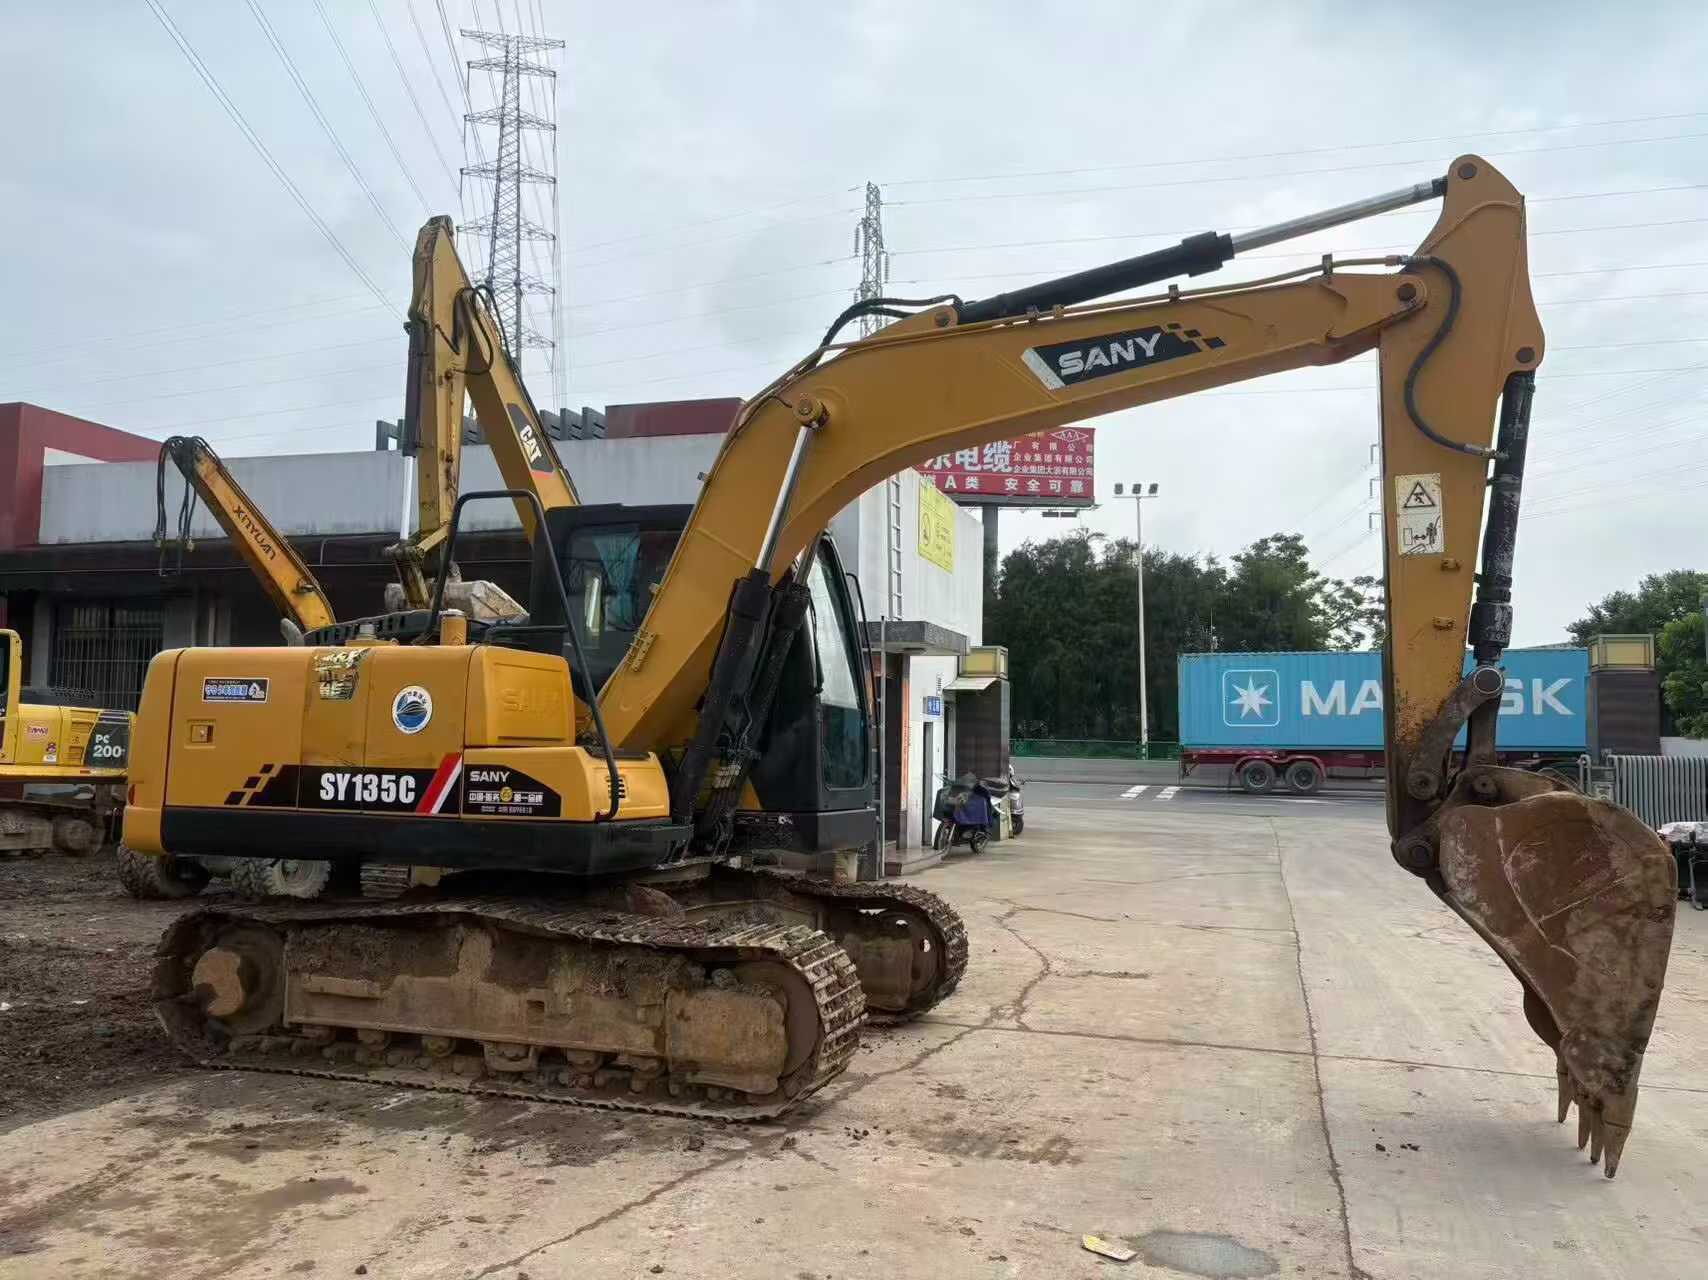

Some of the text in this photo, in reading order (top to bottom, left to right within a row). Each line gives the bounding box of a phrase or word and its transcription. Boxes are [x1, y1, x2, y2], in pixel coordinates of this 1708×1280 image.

[1059, 333, 1161, 376] SANY
[519, 424, 542, 463] CAT
[1004, 477, 1085, 494] 安全可靠
[1301, 678, 1575, 716] MASK
[95, 733, 112, 744] PC
[319, 772, 416, 803] SY135C
[469, 770, 510, 782] SANY
